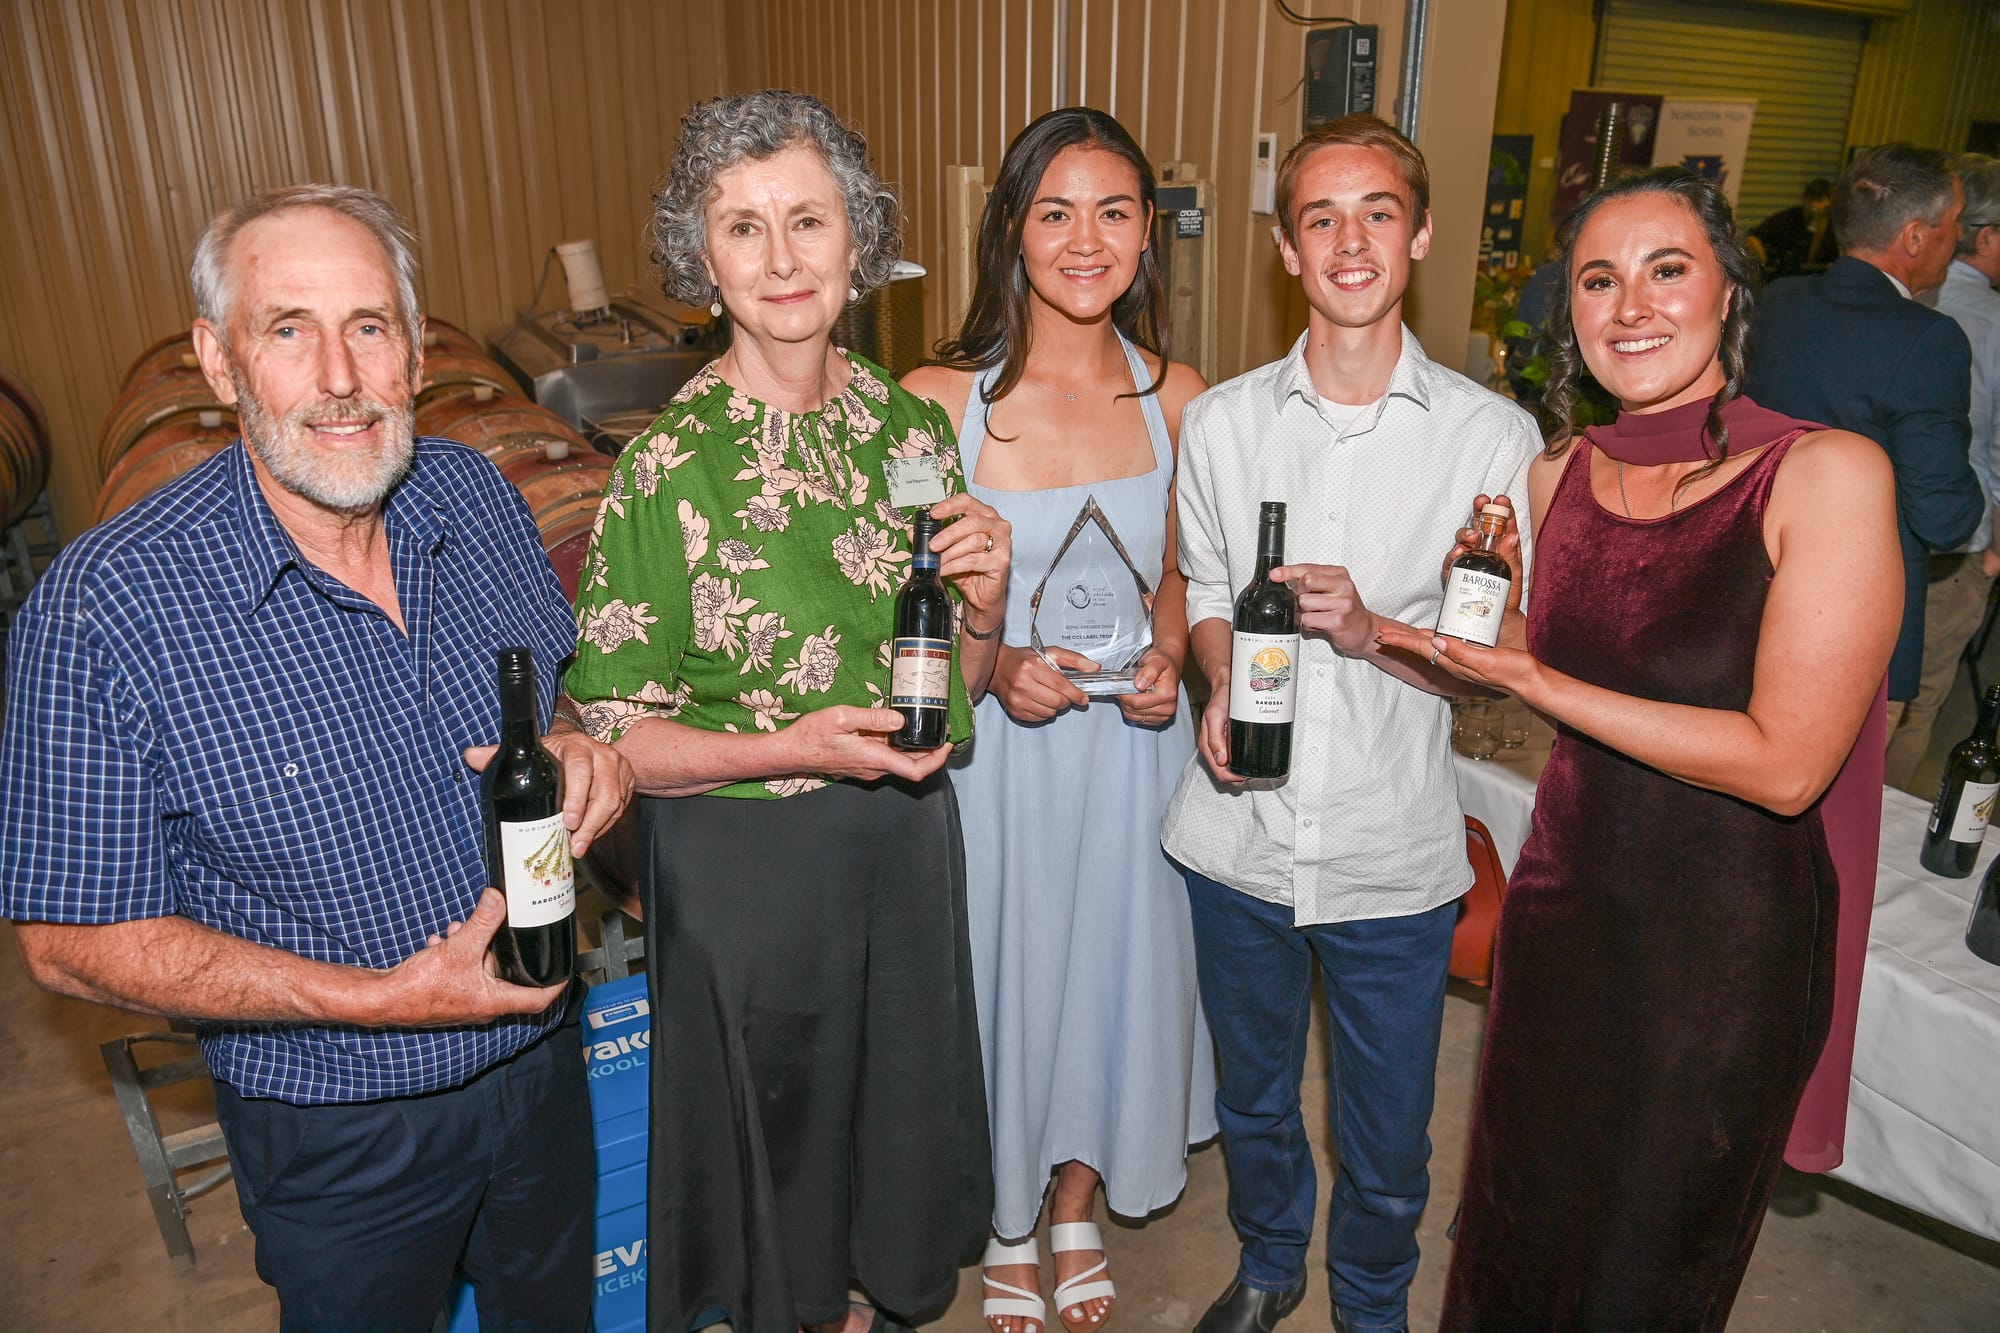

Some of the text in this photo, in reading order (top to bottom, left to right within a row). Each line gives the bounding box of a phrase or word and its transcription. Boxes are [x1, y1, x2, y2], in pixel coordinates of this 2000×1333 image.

[1462, 573, 1501, 592] BAROSSA
[532, 891, 565, 906] BAROSSA
[593, 1238, 647, 1278] EV
